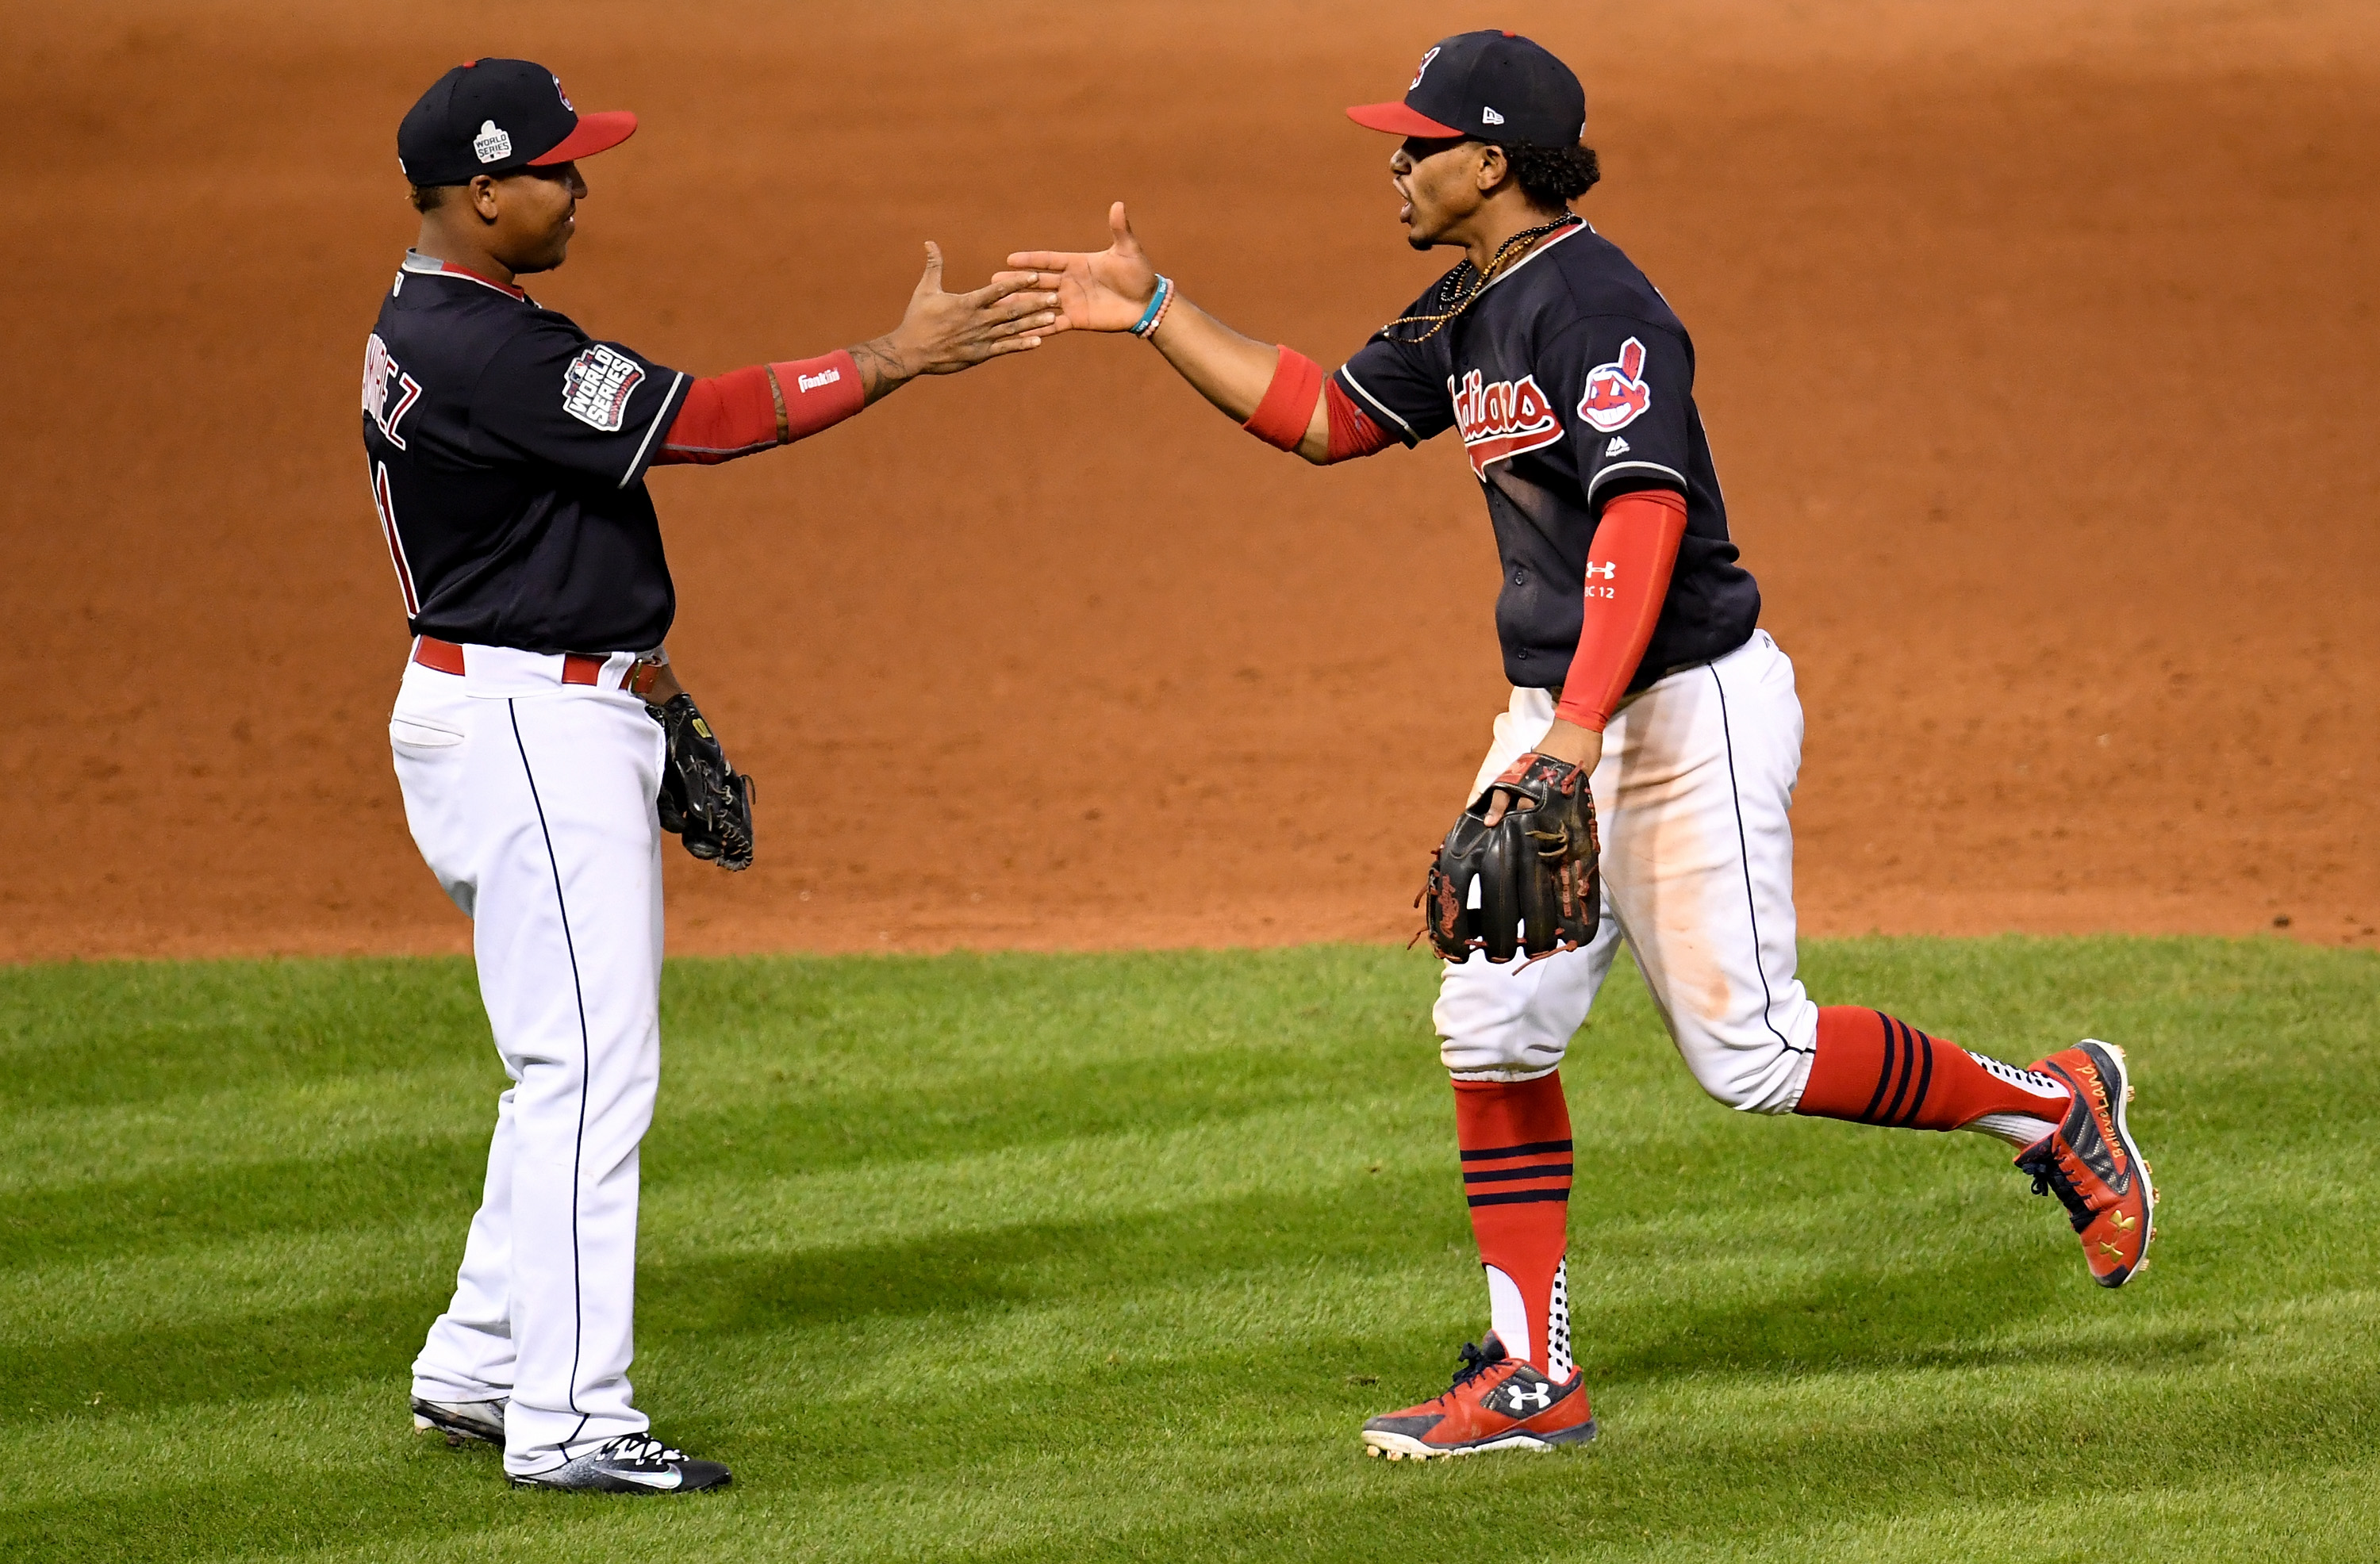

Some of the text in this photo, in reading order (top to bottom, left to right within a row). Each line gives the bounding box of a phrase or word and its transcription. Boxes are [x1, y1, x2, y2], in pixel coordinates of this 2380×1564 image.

[476, 133, 507, 148] WORLD
[478, 142, 510, 158] SERIES
[569, 348, 613, 413] WORLD
[586, 358, 634, 425] SERIES
[1599, 586, 1615, 600] 12
